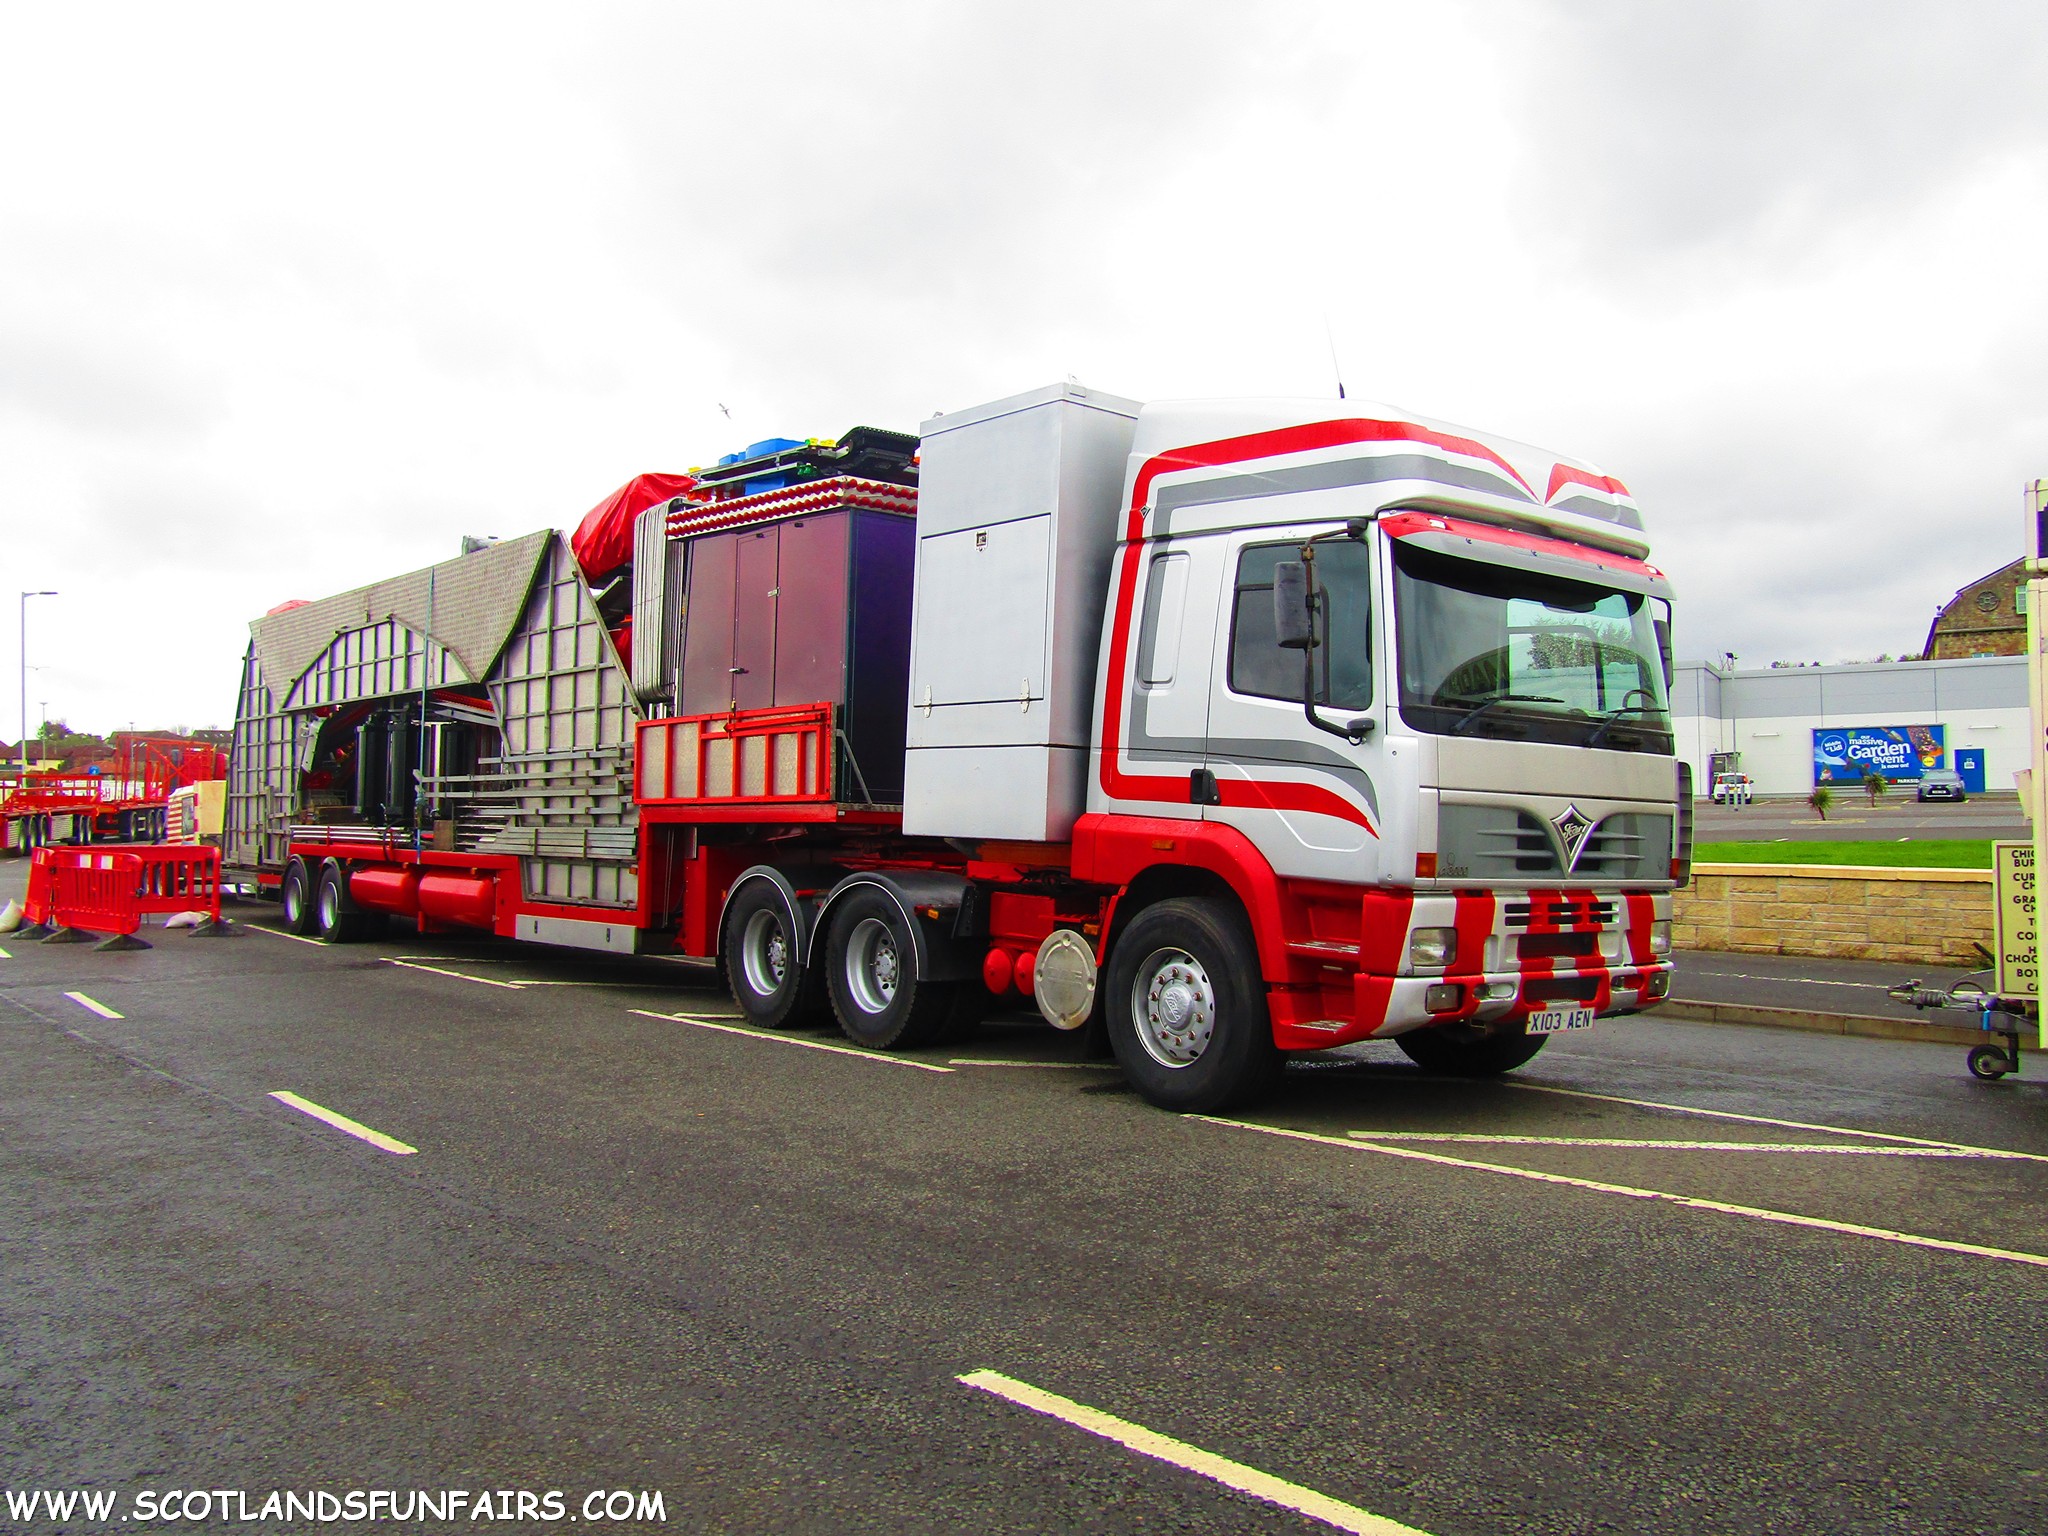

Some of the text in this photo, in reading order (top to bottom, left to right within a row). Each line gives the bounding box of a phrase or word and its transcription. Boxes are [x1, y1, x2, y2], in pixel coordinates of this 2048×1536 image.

[1849, 737, 1883, 745] massive
[1848, 741, 1911, 760] Garden
[1872, 755, 1905, 764] event
[2013, 895, 2036, 904] GRA
[2017, 932, 2037, 940] CO
[2005, 954, 2038, 963] CHOC
[1531, 1010, 1591, 1031] X103 AEN
